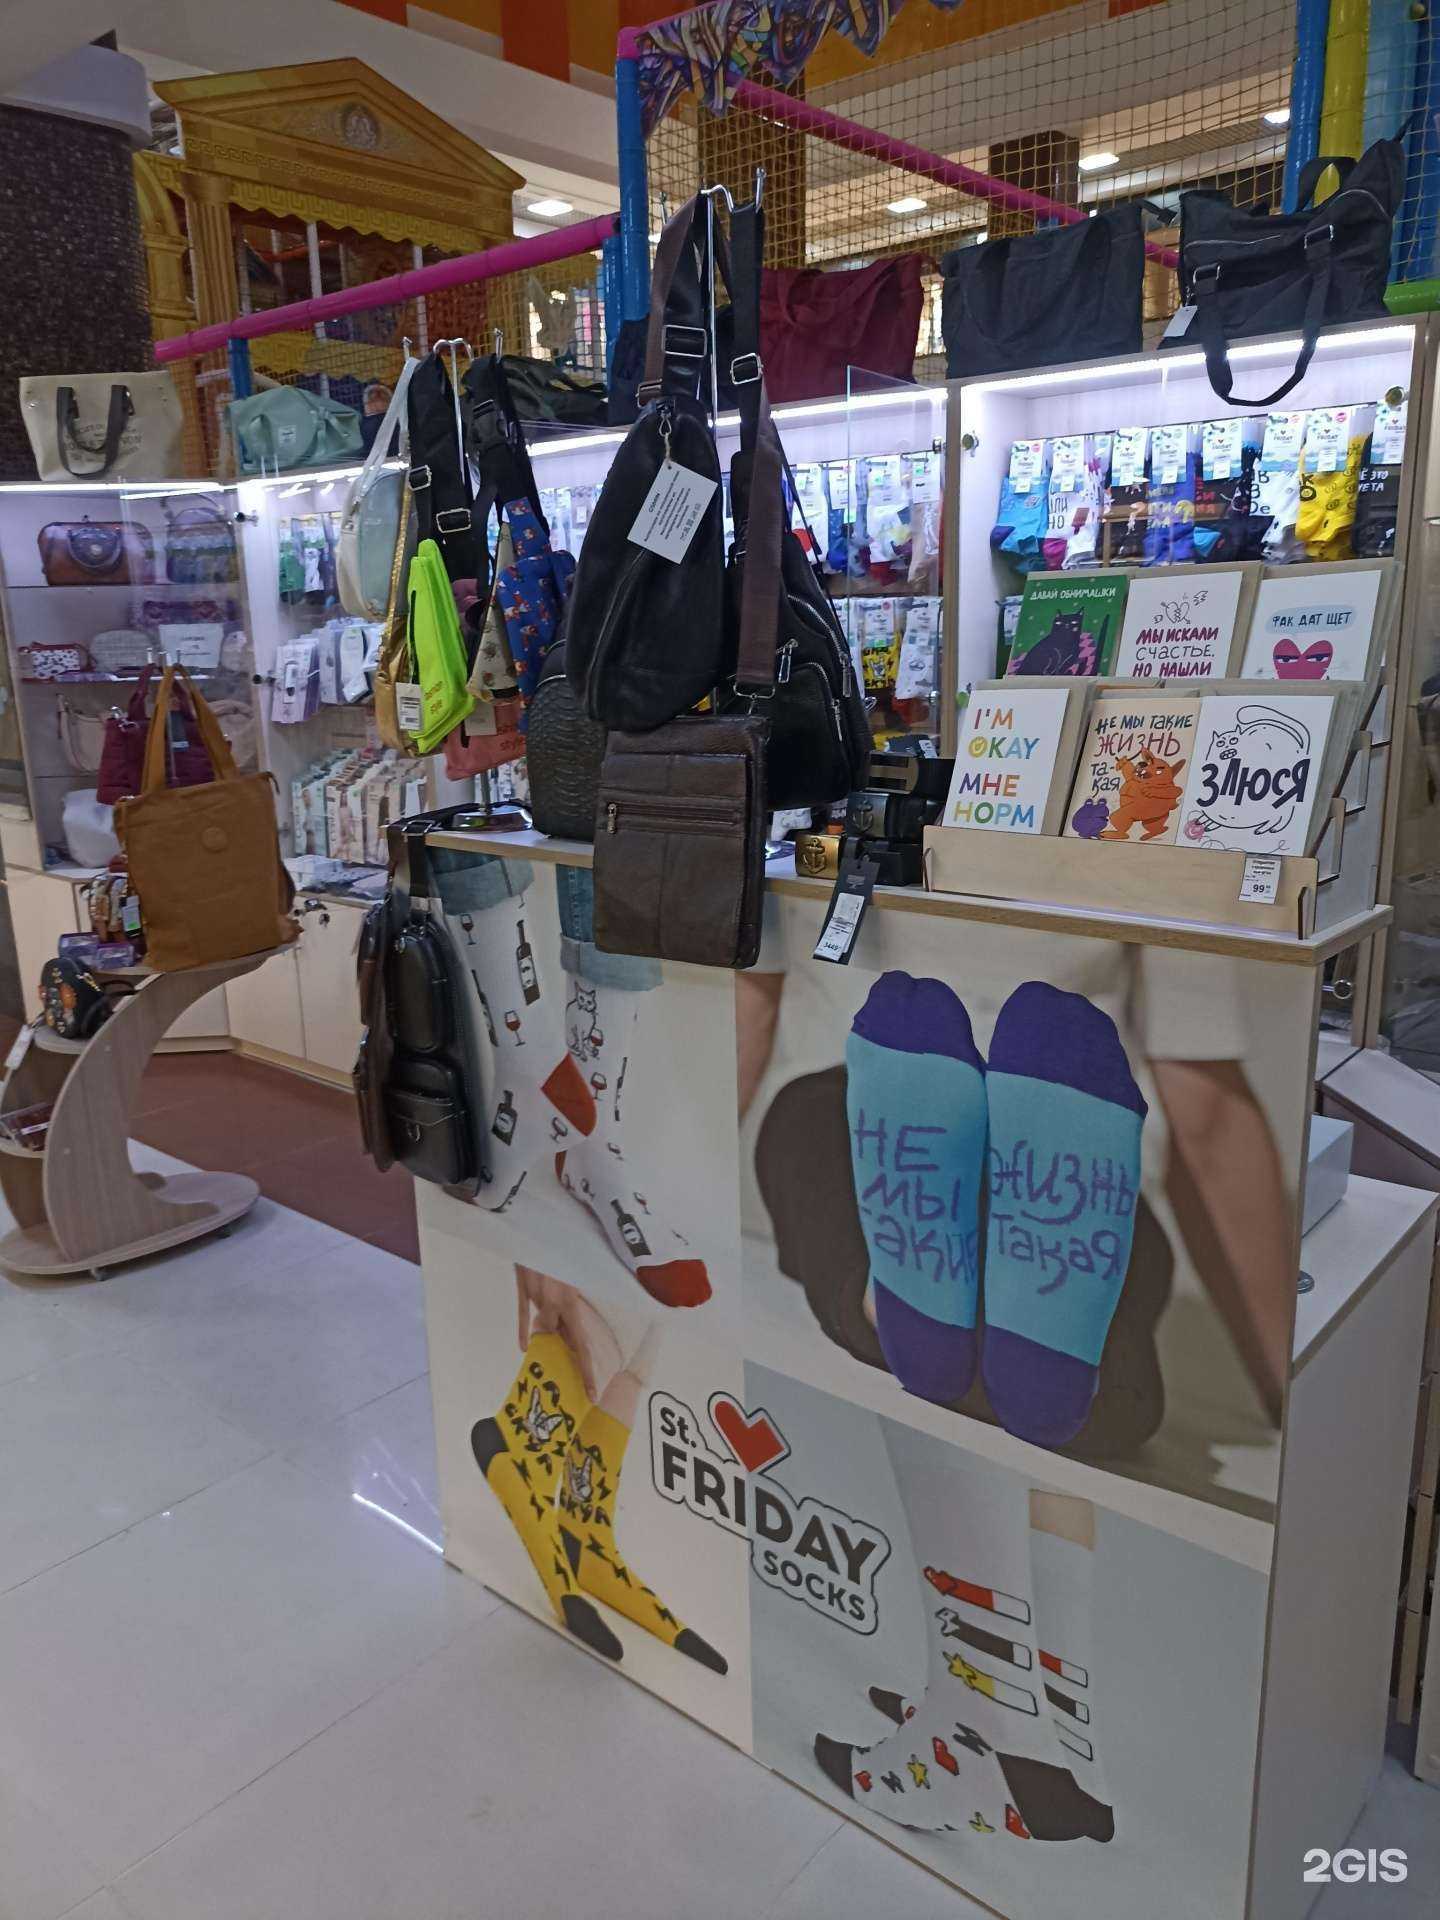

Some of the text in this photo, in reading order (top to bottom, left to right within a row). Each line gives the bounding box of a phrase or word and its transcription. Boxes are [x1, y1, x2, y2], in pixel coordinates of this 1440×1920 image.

[1030, 587, 1117, 601] ДАВАЙ ОБНИМАШКИ
[1298, 613, 1323, 626] ДАТ
[1326, 611, 1353, 626] ЩЕТ
[1136, 627, 1219, 645] МЫ ИСКАЛИ
[1132, 661, 1212, 678] НО НАШЛИ
[1094, 716, 1118, 735] НЕ
[1120, 715, 1146, 730] МЫ
[968, 736, 1040, 760] OKAY
[1093, 731, 1181, 761] ЖИЗНЬ
[959, 772, 1020, 798] МНЕ
[953, 801, 1035, 828] НОРМ
[855, 1108, 947, 1173] НЕ
[990, 1140, 1137, 1226] ЖИЗНЬ
[861, 1173, 960, 1223] МЫ
[660, 1406, 697, 1449] St.
[662, 1441, 878, 1586] FRIDAY
[763, 1550, 866, 1622] SOCKS
